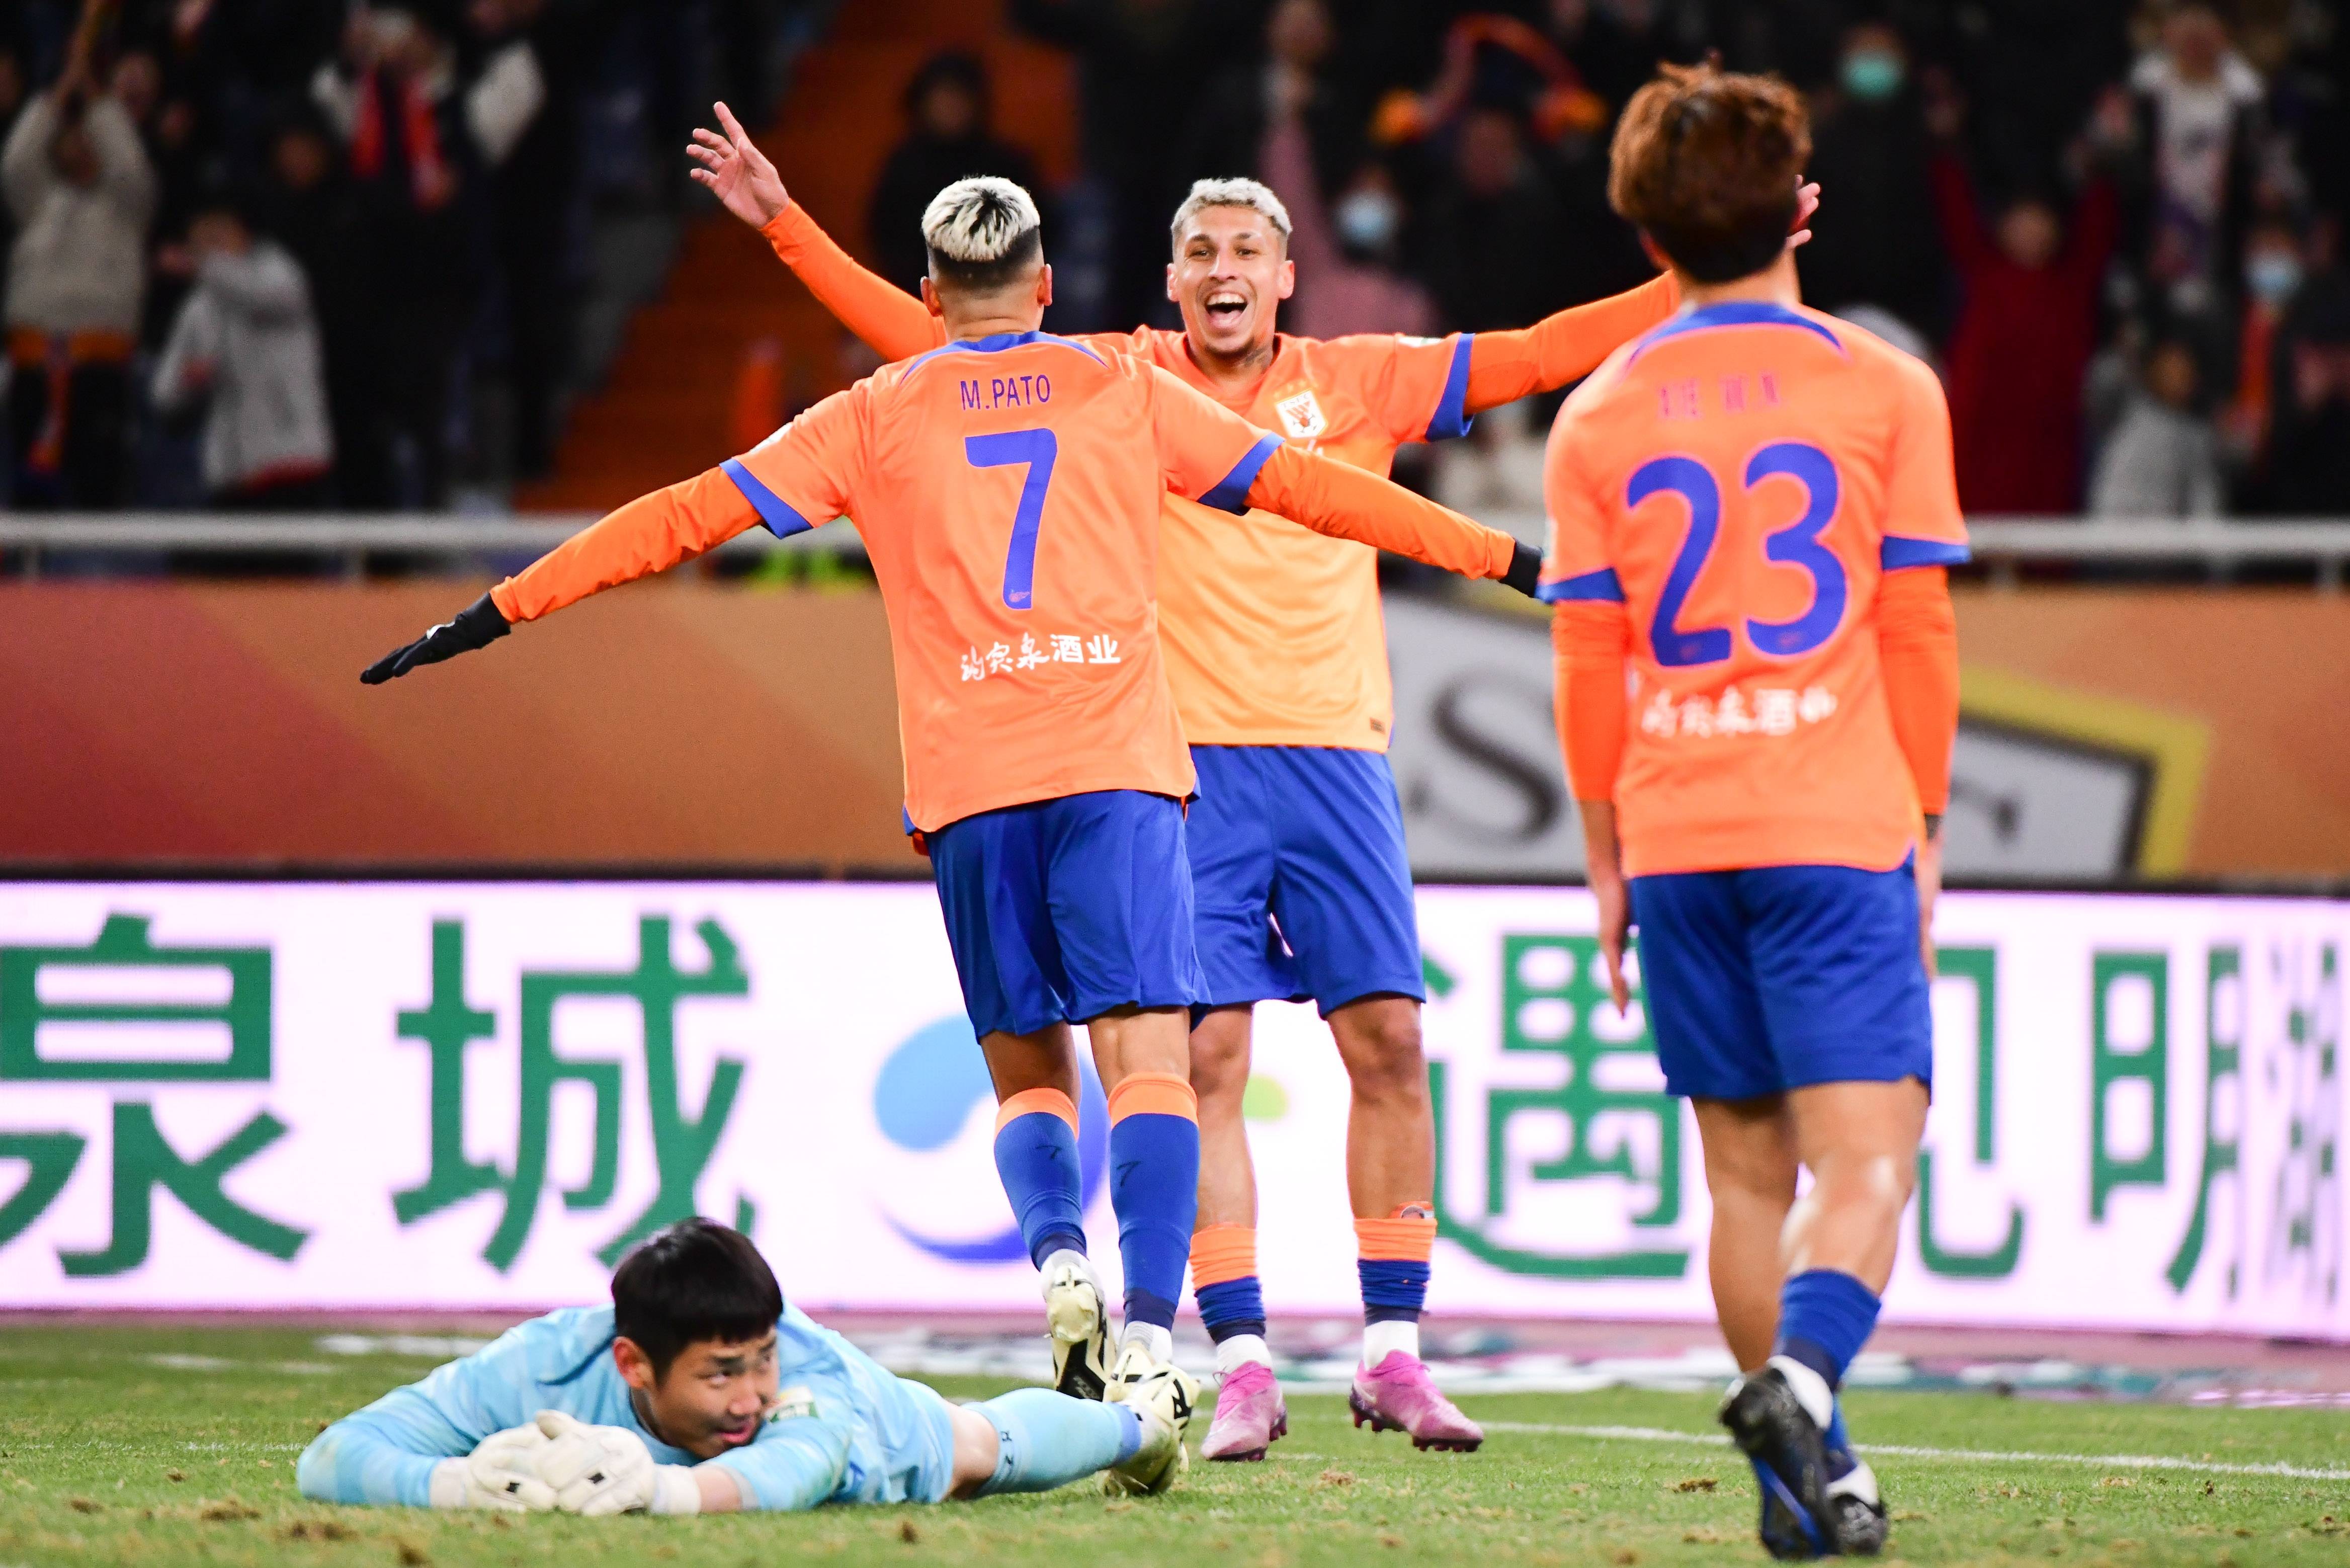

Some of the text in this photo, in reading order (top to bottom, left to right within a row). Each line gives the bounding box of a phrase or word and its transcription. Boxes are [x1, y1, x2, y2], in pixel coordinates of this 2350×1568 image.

[961, 375, 1051, 410] M.PATO
[965, 428, 1058, 610] 7
[1627, 443, 1846, 667] 23
